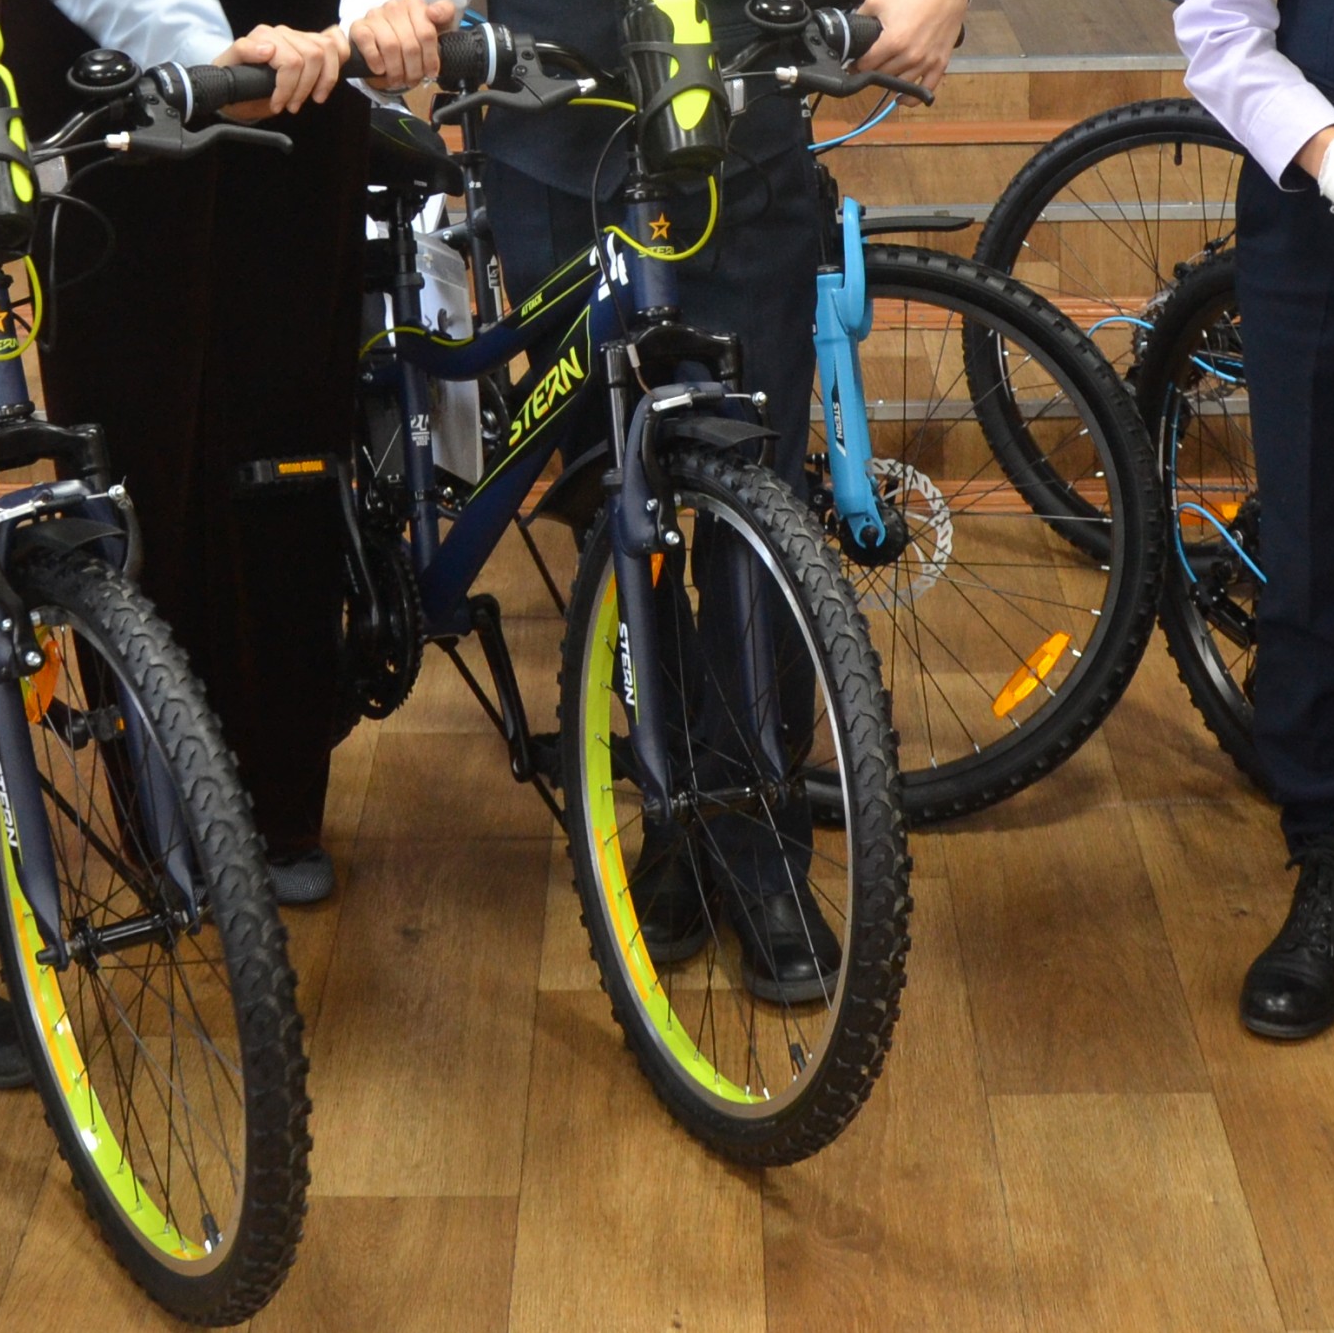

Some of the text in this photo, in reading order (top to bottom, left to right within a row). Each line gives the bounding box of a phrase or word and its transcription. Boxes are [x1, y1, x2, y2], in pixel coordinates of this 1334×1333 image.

[509, 346, 584, 447] STERN
[833, 402, 843, 439] STERN
[619, 620, 635, 706] STERN
